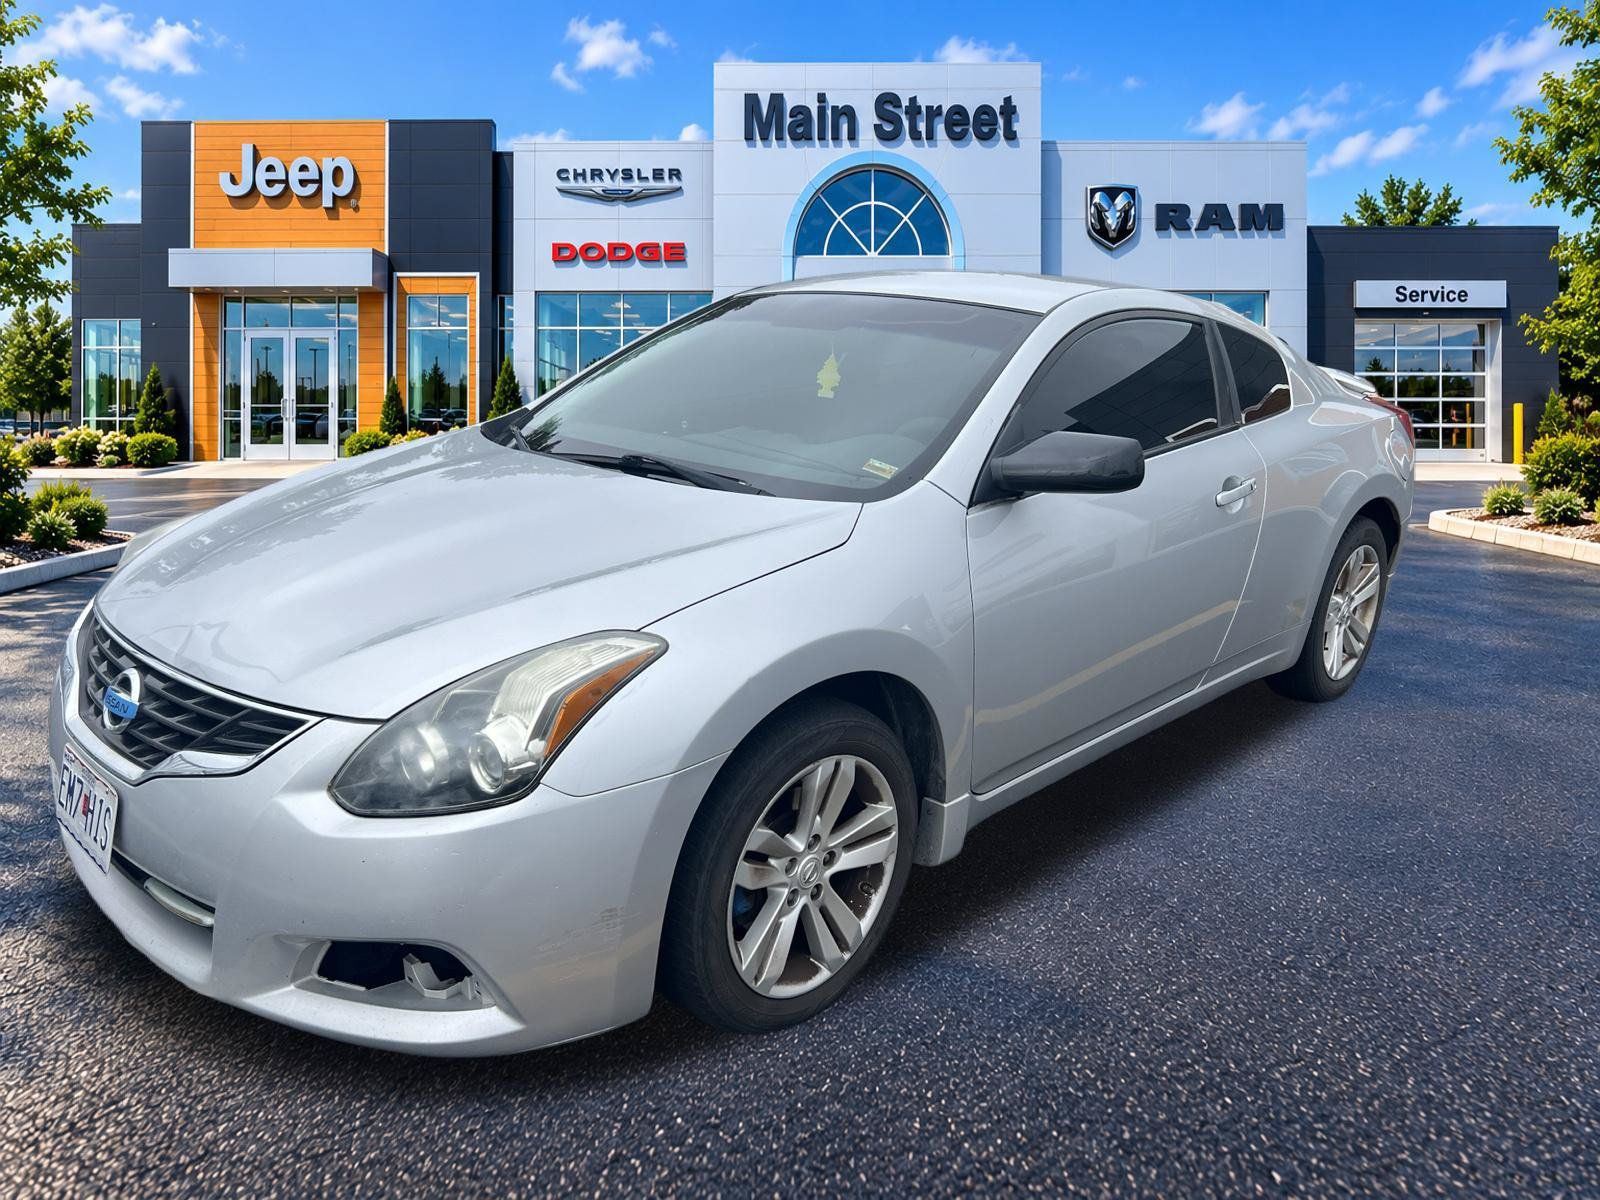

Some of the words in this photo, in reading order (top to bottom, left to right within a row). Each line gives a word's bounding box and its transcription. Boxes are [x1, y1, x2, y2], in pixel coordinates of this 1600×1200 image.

[744, 92, 857, 142] Main
[873, 91, 1017, 142] Street
[218, 143, 355, 208] Jeep
[556, 168, 682, 181] CHRYSLER
[1155, 203, 1284, 231] RAM
[551, 242, 686, 261] DODGE
[1395, 285, 1469, 303] Service
